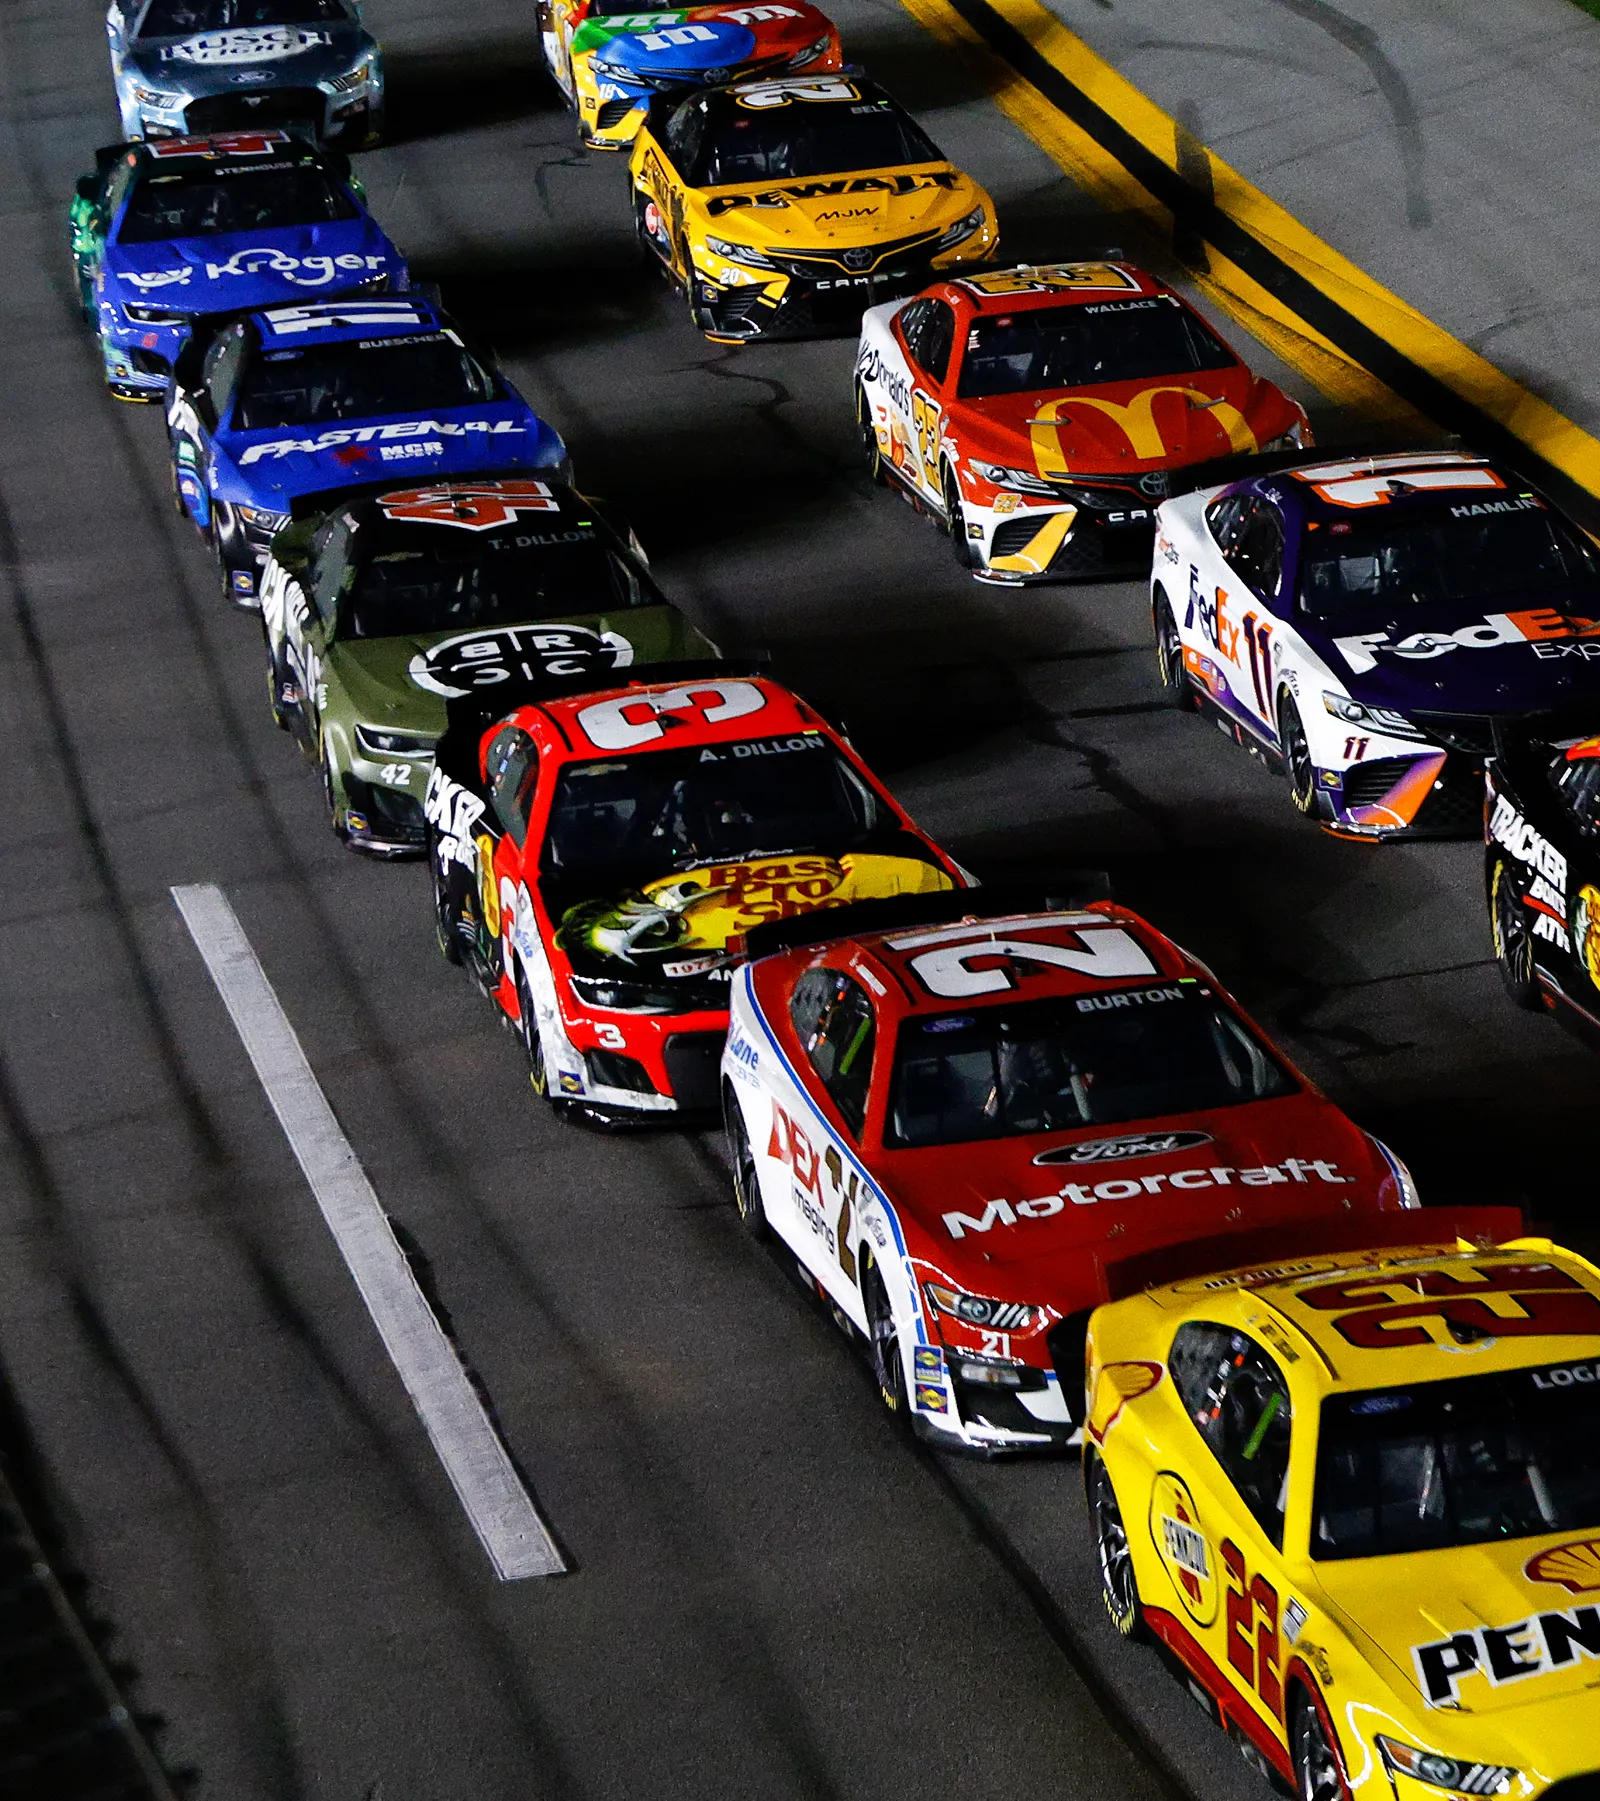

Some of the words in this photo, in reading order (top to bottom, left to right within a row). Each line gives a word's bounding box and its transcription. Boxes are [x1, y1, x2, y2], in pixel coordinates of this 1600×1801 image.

[206, 247, 386, 286] Kroger
[719, 267, 742, 285] 20
[1085, 300, 1160, 314] WALLACE
[238, 420, 528, 466] FASTENAL
[1450, 498, 1542, 518] HAMLIN
[516, 529, 596, 548] DILLON
[577, 681, 767, 751] 3
[700, 748, 726, 763] A.
[732, 736, 825, 757] DILLON
[1343, 736, 1370, 760] 11
[380, 763, 412, 785] 42
[1490, 793, 1568, 894] TRACKER
[1075, 987, 1185, 1014] BURTON
[594, 1022, 628, 1050] 3
[1070, 1133, 1180, 1162] Ford
[791, 1177, 836, 1256] imaging
[981, 1331, 1011, 1358] 21
